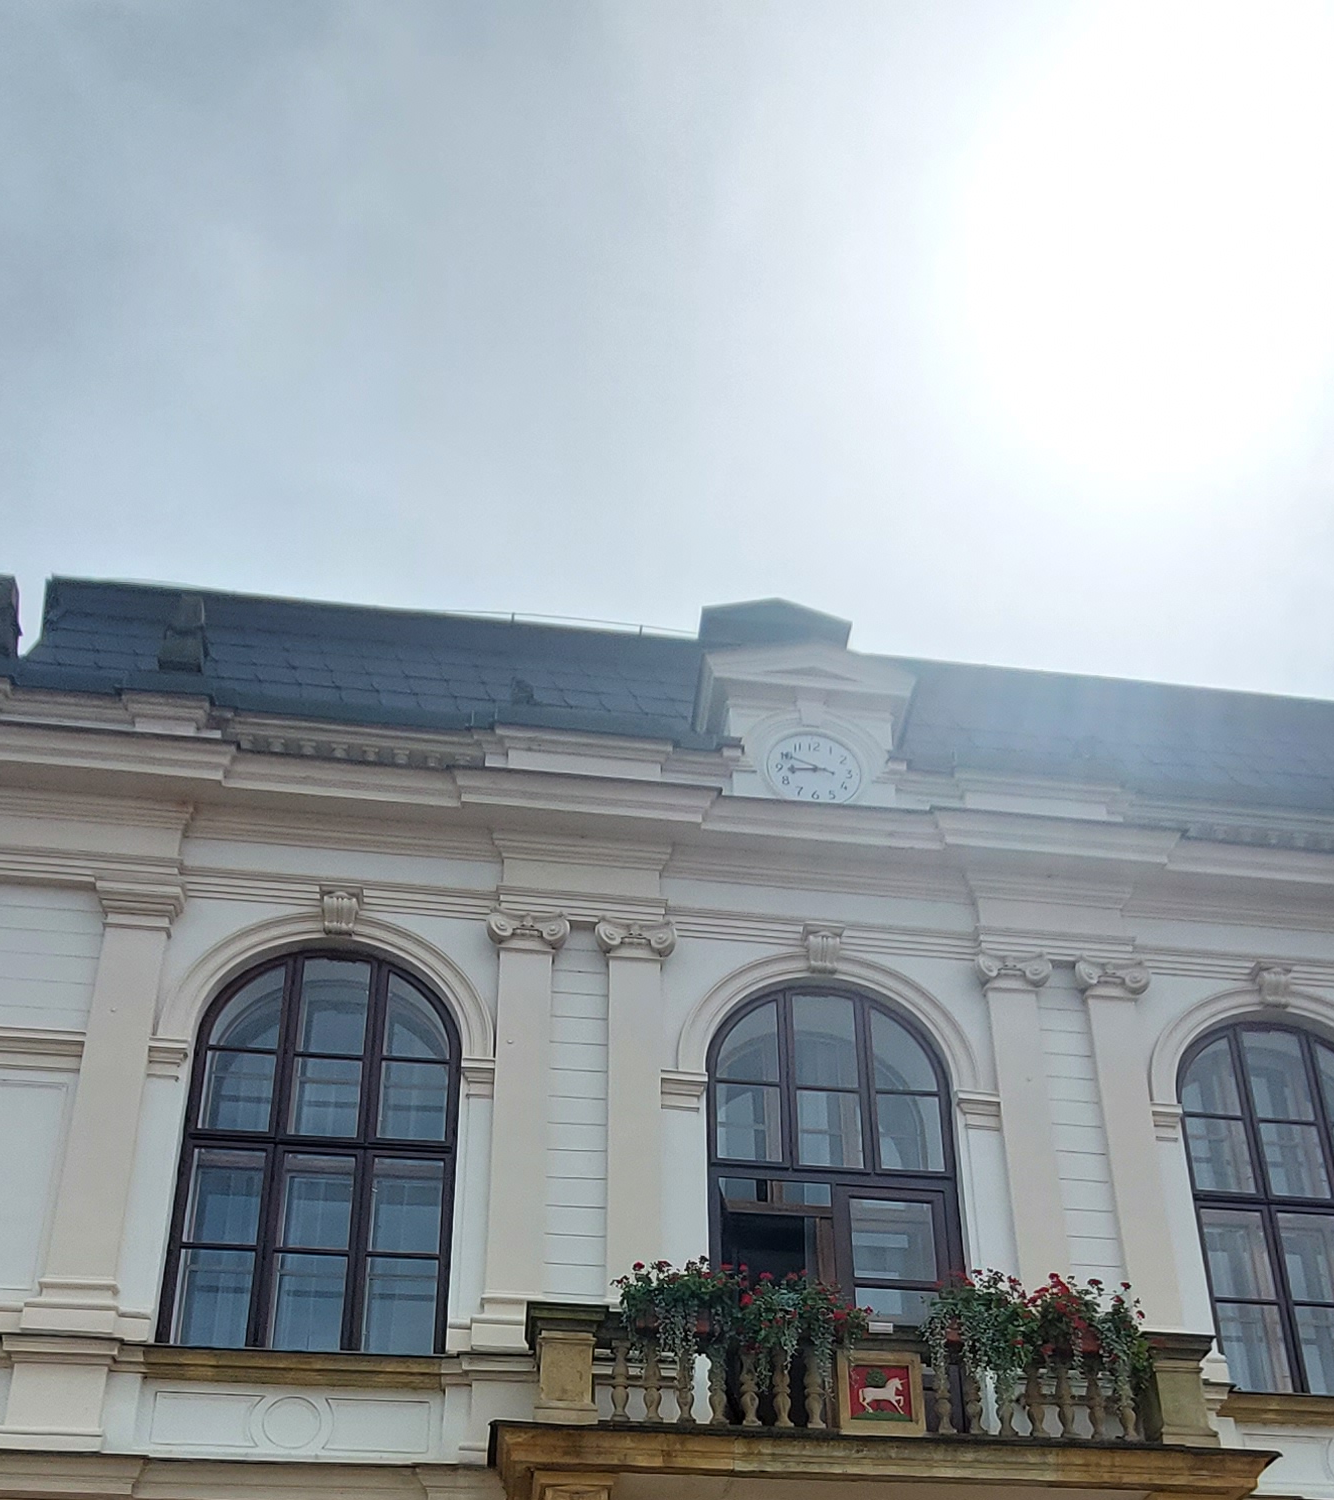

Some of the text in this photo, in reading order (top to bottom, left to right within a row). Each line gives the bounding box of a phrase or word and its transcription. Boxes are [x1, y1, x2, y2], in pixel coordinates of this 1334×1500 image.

[794, 742, 802, 753] 11
[808, 742, 820, 752] 12
[839, 754, 847, 765] 2
[775, 763, 784, 773] 9
[846, 770, 853, 779] 3
[782, 775, 790, 786] 8
[795, 786, 804, 796] 7
[840, 781, 848, 791] 4
[811, 790, 820, 800] 6
[828, 790, 836, 800] 5
